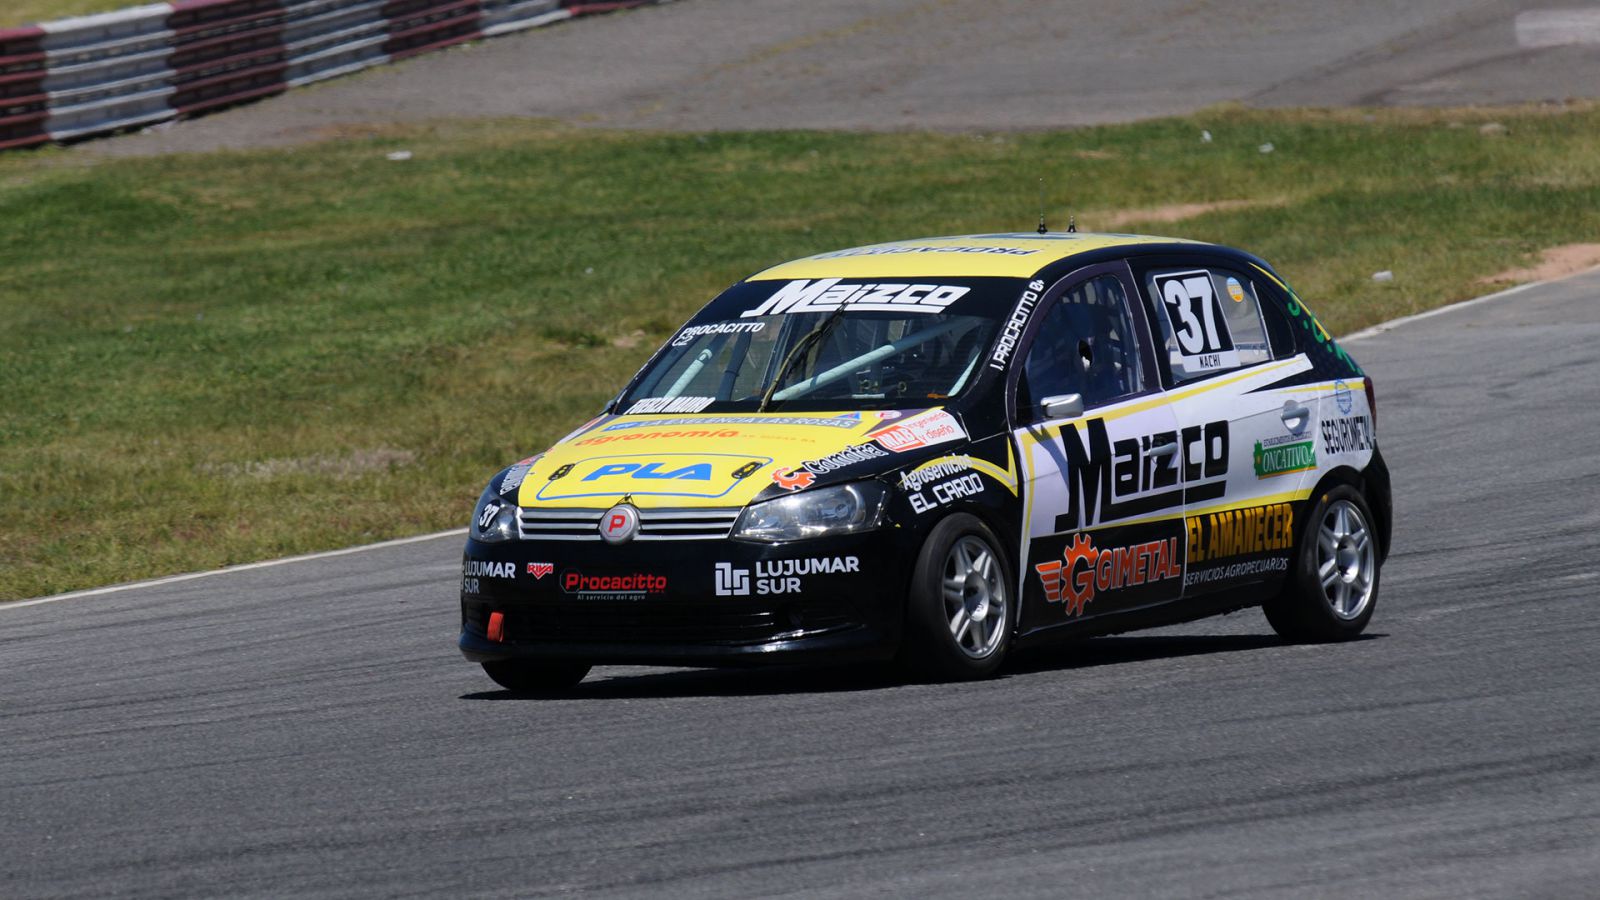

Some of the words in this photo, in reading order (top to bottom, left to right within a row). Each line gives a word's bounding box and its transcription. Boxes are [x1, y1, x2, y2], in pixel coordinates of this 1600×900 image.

[1164, 277, 1221, 353] 37
[679, 322, 765, 339] PROCACITTO
[992, 290, 1038, 364] PROCACITTO
[1199, 354, 1221, 367] NACHI
[793, 418, 855, 428] ROSAS
[574, 429, 740, 447] agronomía
[1263, 445, 1309, 473] ONCATIVO
[580, 462, 712, 482] PLA
[900, 453, 973, 492] Agroservicios
[908, 493, 938, 514] EL
[932, 473, 985, 504] CARDO
[479, 503, 499, 528] 37
[608, 515, 626, 532] P
[1186, 517, 1204, 563] EL
[1208, 504, 1293, 560] AMANECER
[464, 560, 516, 579] LUJUMAR
[756, 556, 860, 578] LUJUMAR
[1096, 536, 1182, 591] GIMETAL
[1185, 566, 1225, 586] SERVICIOS
[1224, 558, 1289, 579] AGROPECUARIOS
[464, 578, 480, 594] SUR
[566, 572, 667, 590] Procacitto
[756, 577, 801, 595] SUR
